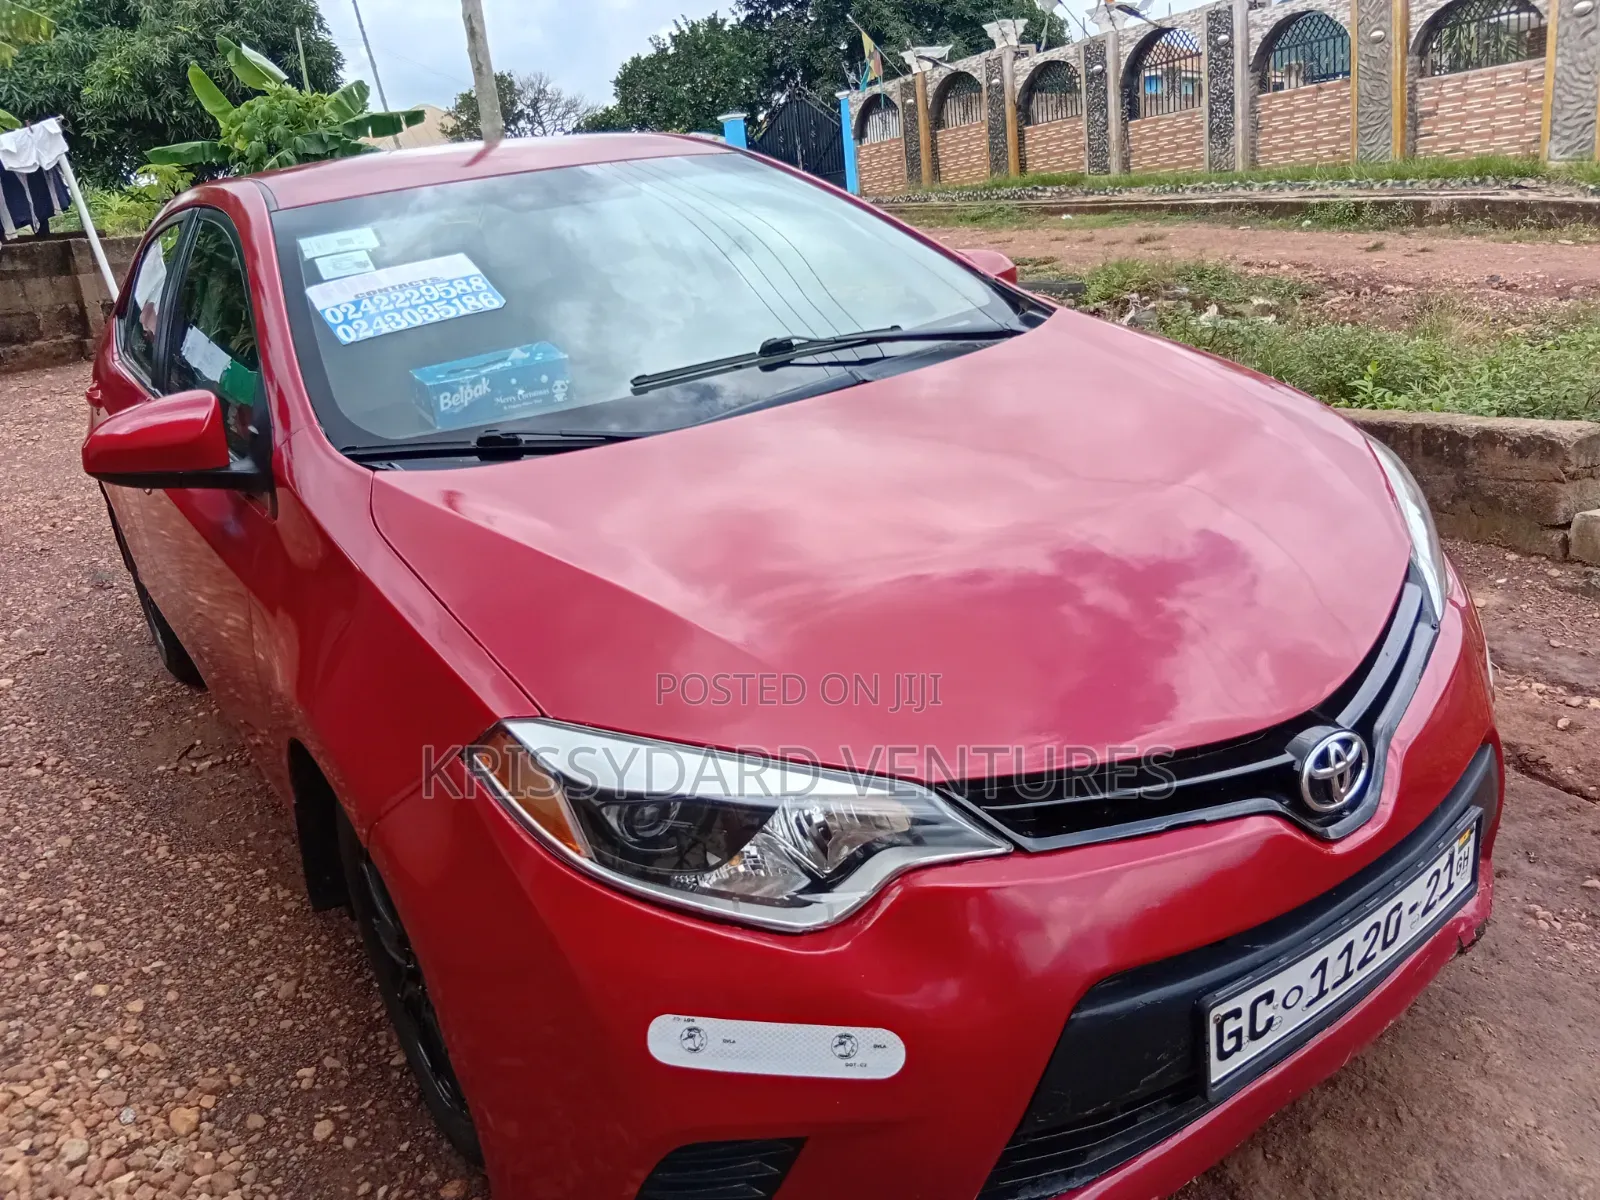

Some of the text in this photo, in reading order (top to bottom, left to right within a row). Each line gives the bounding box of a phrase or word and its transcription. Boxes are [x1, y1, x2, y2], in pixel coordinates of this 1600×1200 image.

[324, 275, 488, 325] 0242229588
[336, 291, 500, 343] 0243035186
[439, 376, 491, 412] Belpak
[1456, 846, 1470, 876] GH
[1215, 846, 1456, 1061] GC 1120-21
